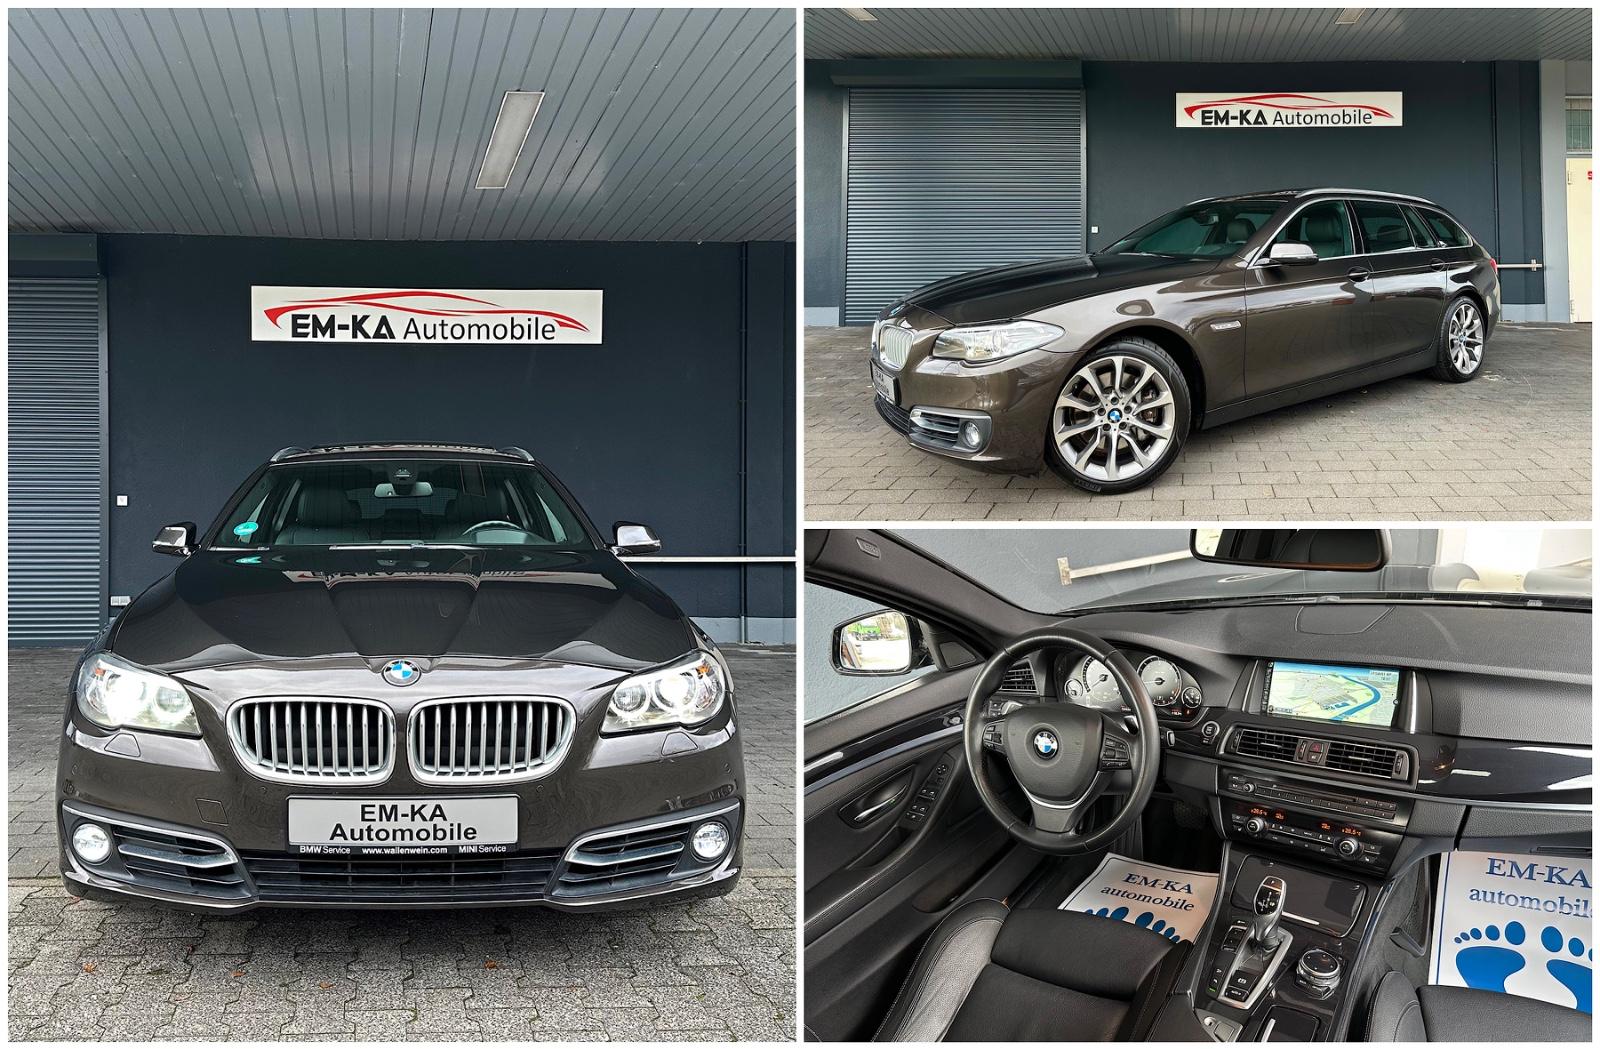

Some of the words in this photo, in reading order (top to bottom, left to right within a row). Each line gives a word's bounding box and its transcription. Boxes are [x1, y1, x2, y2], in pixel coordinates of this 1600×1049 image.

[1201, 110, 1268, 126] EM-KA
[1272, 109, 1373, 126] Automobile
[290, 313, 396, 340] EM-KA
[403, 317, 556, 341] Automobile
[360, 804, 448, 822] EM-KA
[329, 823, 478, 842] Automobile
[299, 845, 322, 854] BMW
[322, 845, 351, 855] Service
[362, 846, 448, 855] www.wallenwein.com
[458, 845, 478, 853] MINI
[478, 844, 507, 853] Service
[1486, 858, 1592, 889] EM-KA
[1123, 873, 1193, 894] EM-KA
[1101, 886, 1195, 911] automobile
